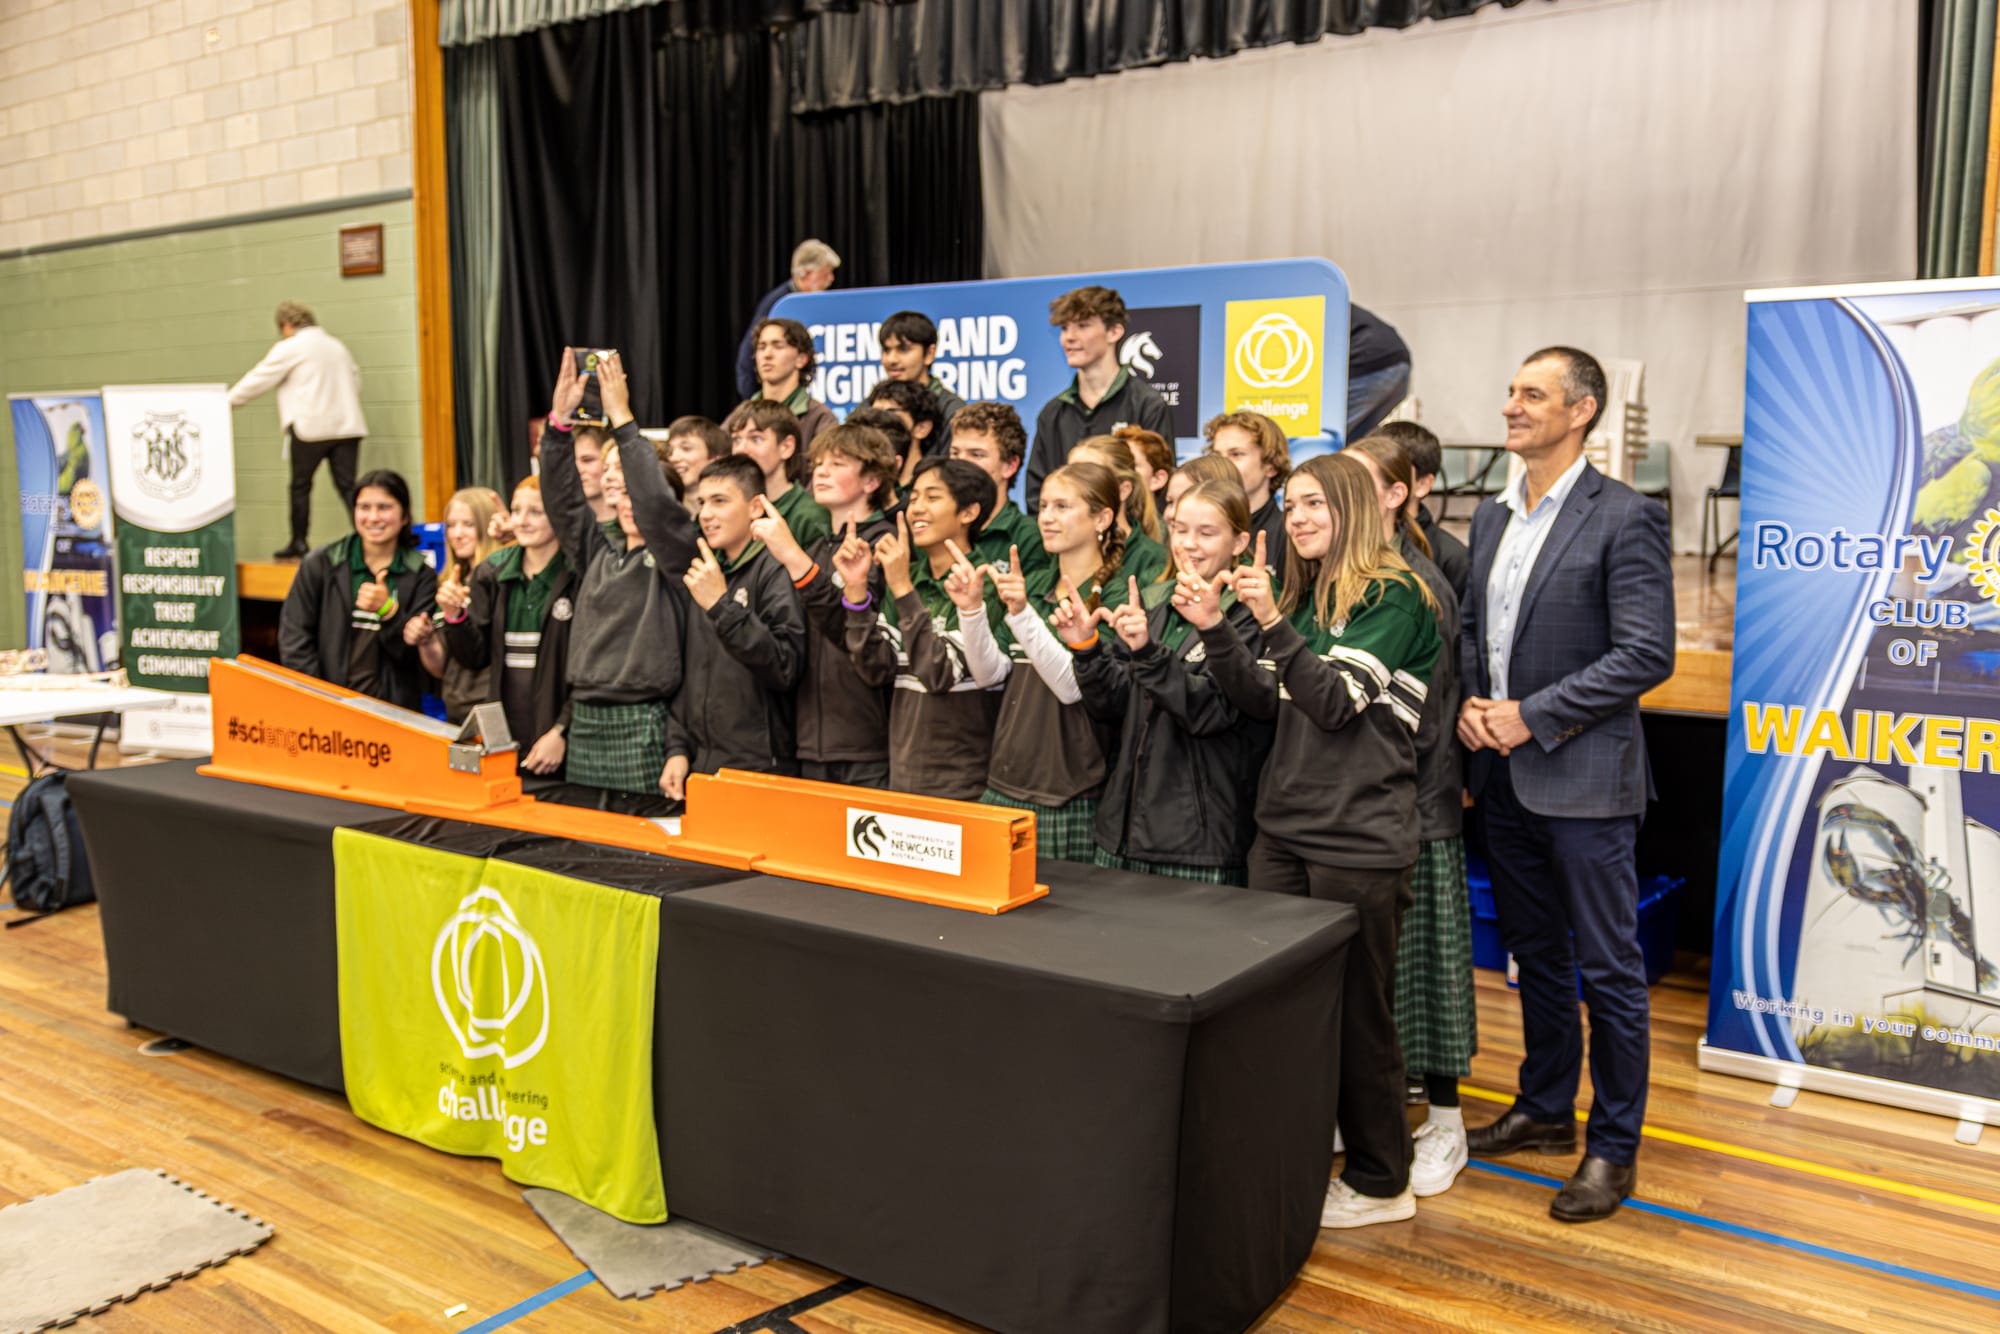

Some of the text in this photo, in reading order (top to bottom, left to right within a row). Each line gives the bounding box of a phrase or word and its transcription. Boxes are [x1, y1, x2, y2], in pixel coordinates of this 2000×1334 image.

[807, 315, 1018, 364] CIEN AND
[1236, 400, 1309, 420] challenge
[144, 547, 200, 568] RESPECT
[1754, 521, 1953, 584] Rotary
[122, 574, 225, 596] RESPONSIBILITY
[153, 601, 196, 622] TRUST
[1868, 598, 1970, 629] CLUB
[131, 627, 220, 651] ACHIEVEMENT
[1887, 638, 1939, 667] OF
[138, 655, 210, 677] COMMUNIT
[228, 716, 392, 768] #sciengchallenge
[891, 839, 955, 861] NEWCASTLE
[1732, 989, 2000, 1052] Working in your comm
[469, 1071, 496, 1086] and
